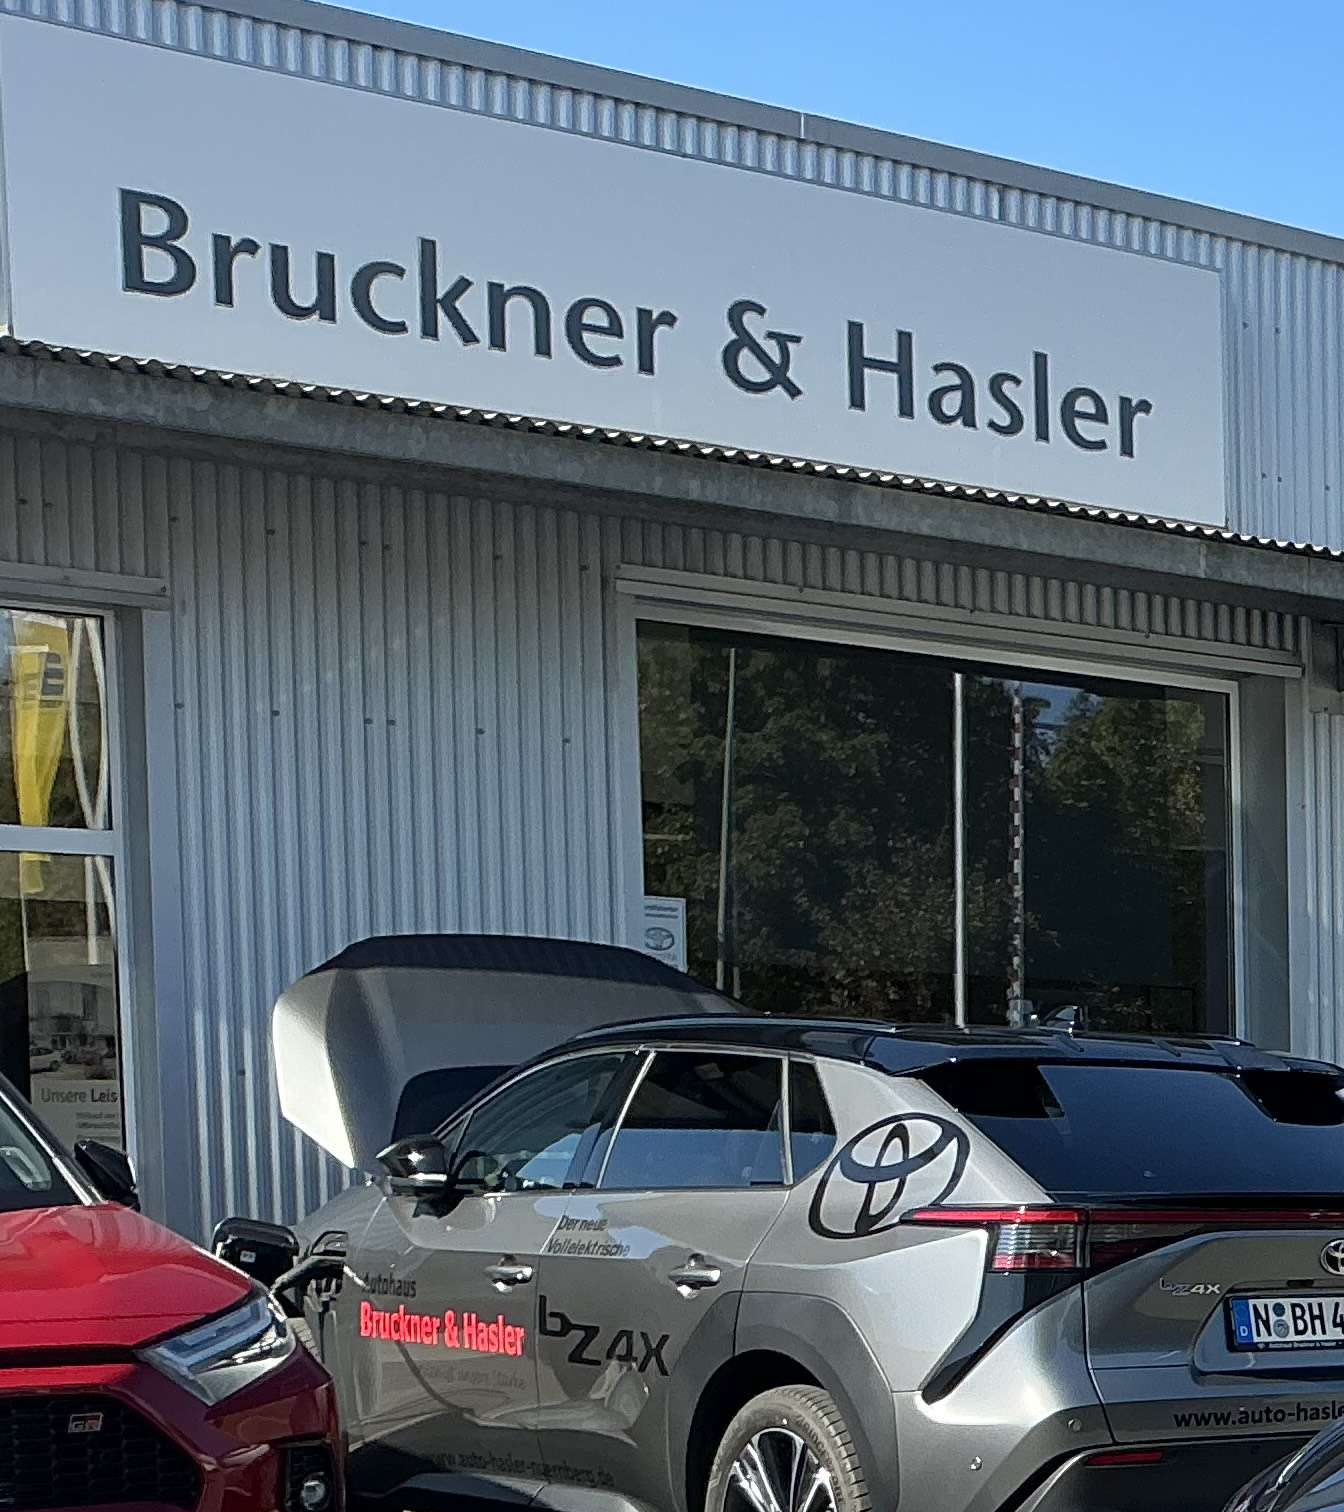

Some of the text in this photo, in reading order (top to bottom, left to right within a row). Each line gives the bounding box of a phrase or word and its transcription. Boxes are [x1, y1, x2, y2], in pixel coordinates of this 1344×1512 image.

[118, 187, 1153, 459] Bruckner & Hasler
[41, 1087, 119, 1103] Unsere Leis
[557, 1214, 608, 1232] Der neue
[360, 1271, 417, 1298] Autohaus
[360, 1301, 526, 1357] Bruckner & Hasler
[1252, 1302, 1273, 1338] N
[1291, 1301, 1327, 1337] BH
